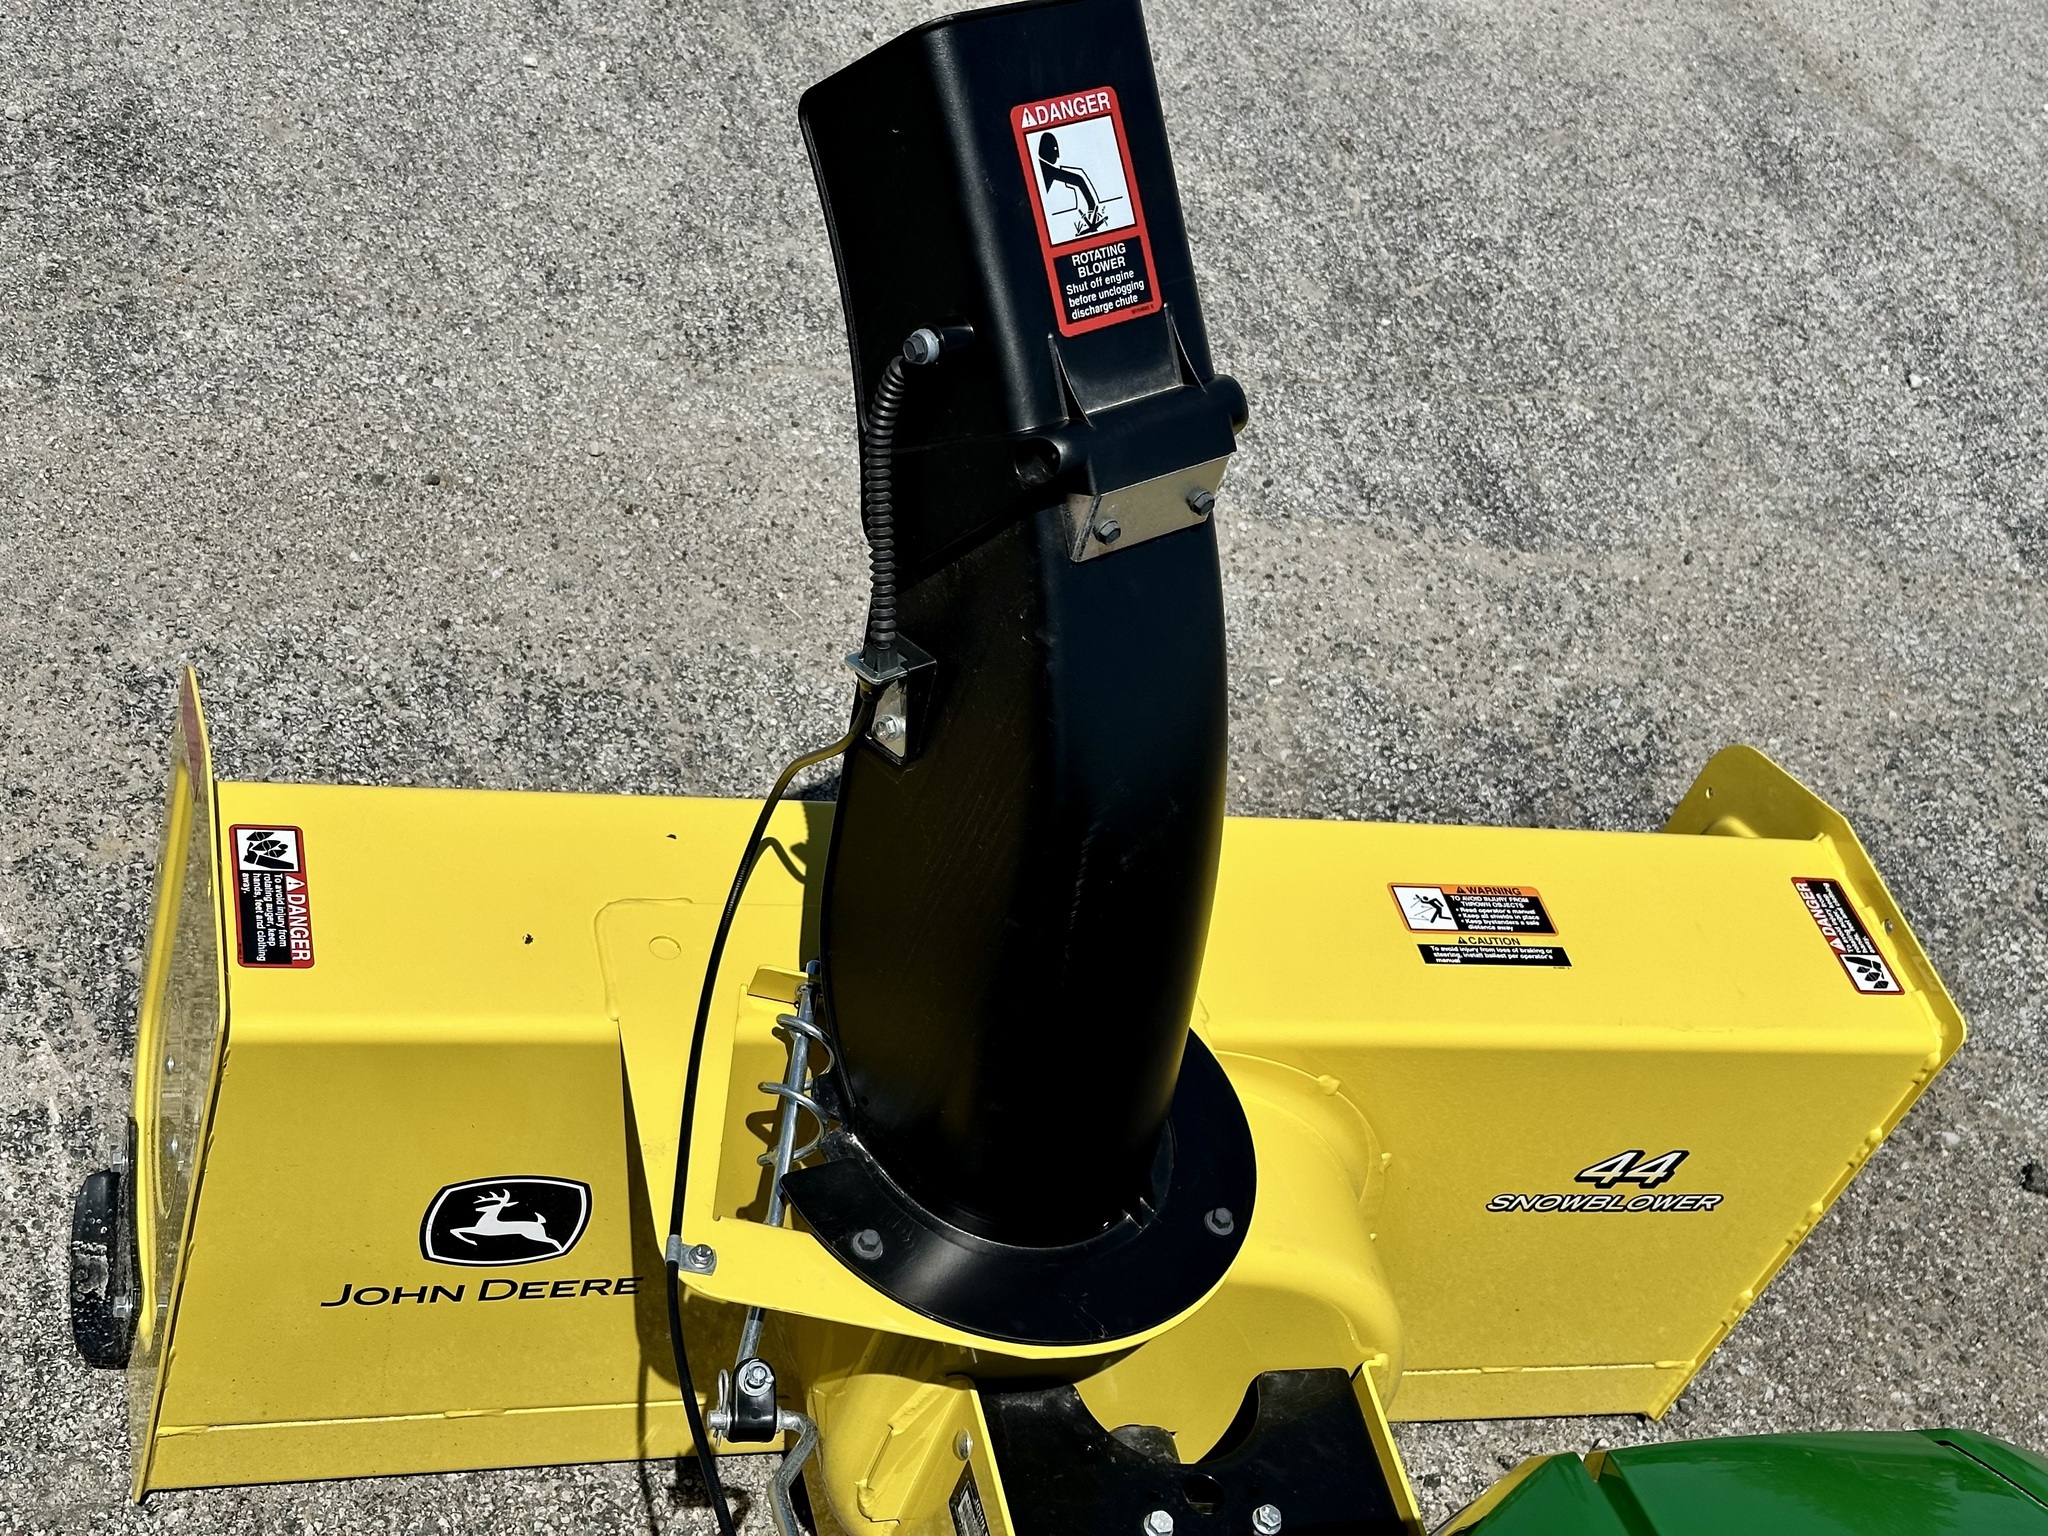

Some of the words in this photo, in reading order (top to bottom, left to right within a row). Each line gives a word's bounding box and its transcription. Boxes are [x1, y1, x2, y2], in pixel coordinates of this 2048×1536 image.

[1035, 92, 1111, 124] DANGER
[1072, 242, 1126, 266] ROTATING
[1078, 256, 1126, 278] BLOWER
[1066, 284, 1088, 295] Shut
[1090, 276, 1102, 288] off
[1105, 270, 1134, 284] engine
[1068, 293, 1096, 308] before
[1098, 280, 1145, 299] unclogging
[1072, 302, 1114, 320] discharge
[1115, 294, 1138, 308] chute
[241, 873, 250, 894] away.
[252, 874, 262, 898] hands,
[264, 873, 274, 902] rotating
[274, 874, 283, 883] To
[275, 884, 285, 905] avoid
[1466, 886, 1522, 896] WARNING
[255, 899, 264, 914] feet
[264, 903, 274, 926] auger,
[275, 906, 286, 927] injury
[1796, 883, 1838, 936] DANGER
[256, 914, 266, 929] and
[287, 894, 310, 960] DANGER
[256, 930, 268, 962] clothing
[267, 928, 276, 946] keep
[278, 928, 288, 947] from
[1468, 937, 1520, 945] CAUTION
[1574, 1150, 1690, 1189] 44
[1486, 1194, 1724, 1212] SNOWBLOWER
[321, 1283, 465, 1307] JOHN
[478, 1276, 644, 1301] DEERE
